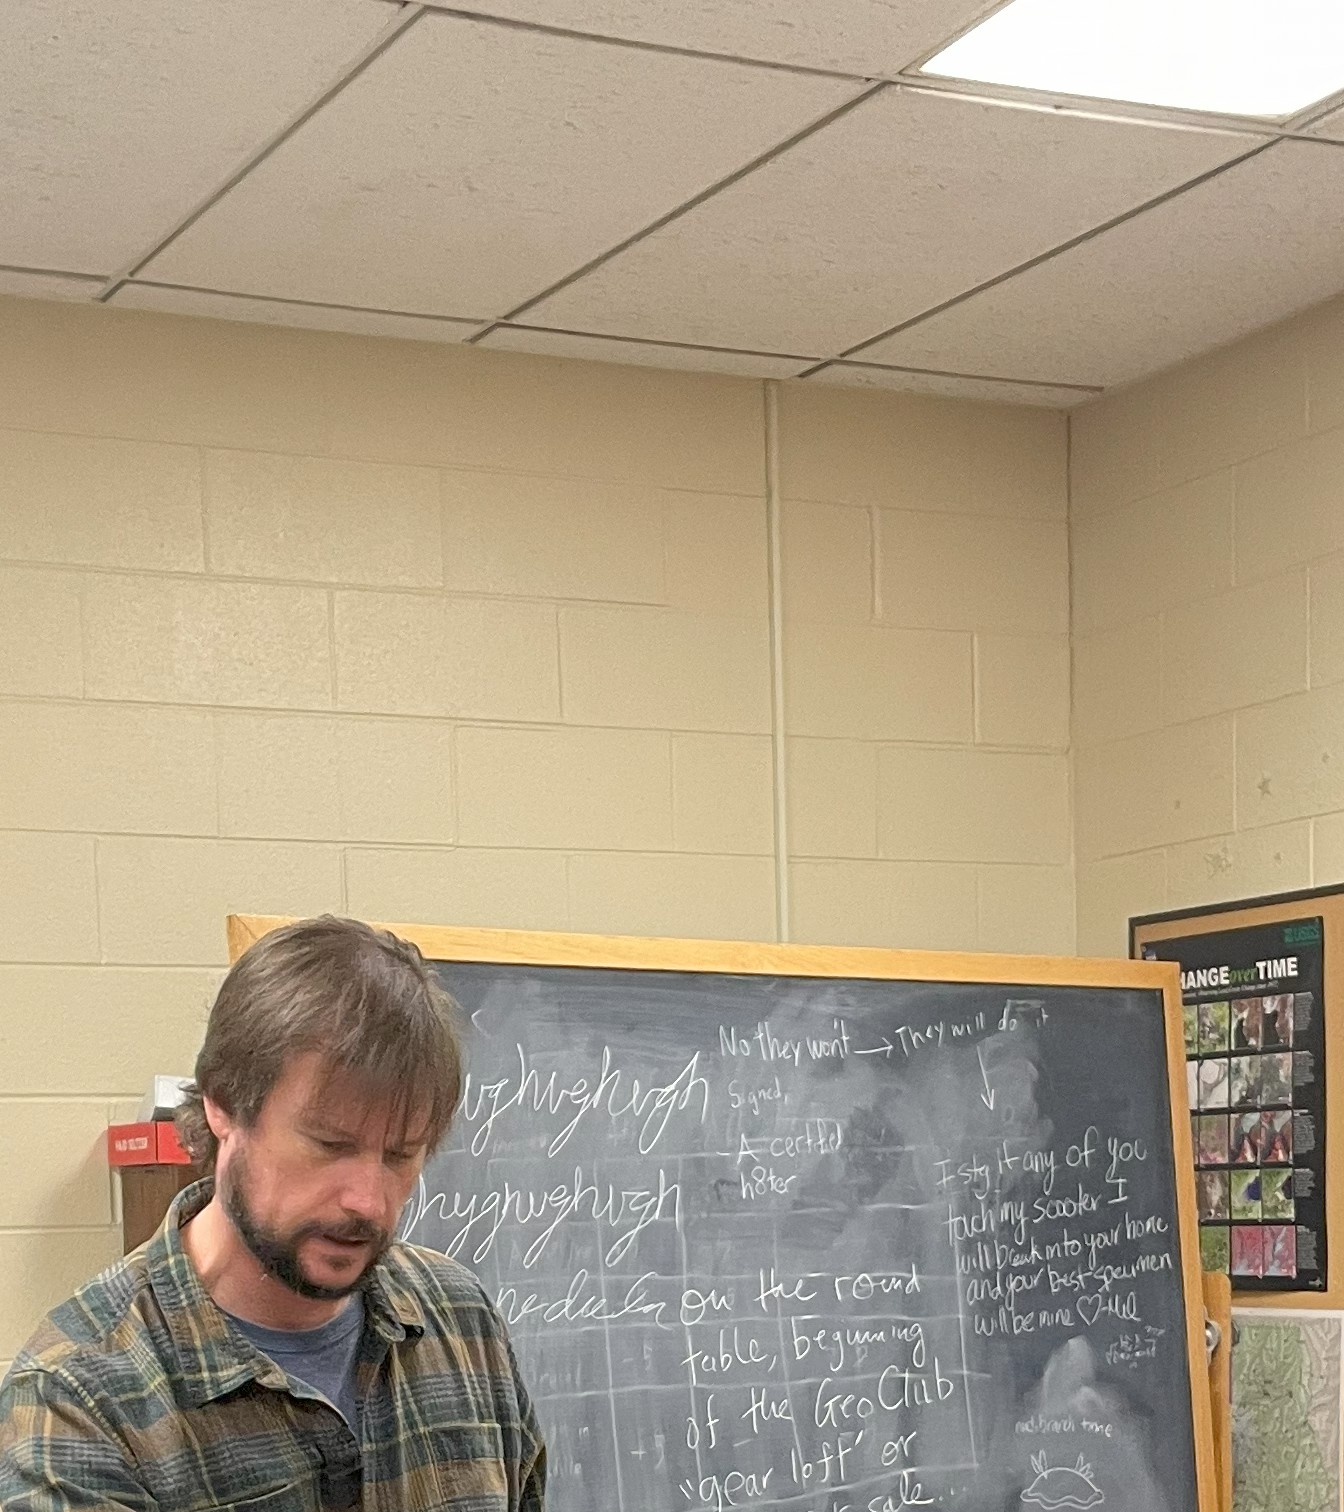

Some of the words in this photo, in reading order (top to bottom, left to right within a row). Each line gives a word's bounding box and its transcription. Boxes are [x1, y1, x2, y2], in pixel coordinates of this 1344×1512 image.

[1180, 966, 1230, 990] HANGE
[1256, 956, 1299, 980] TIME
[719, 1024, 750, 1057] No
[752, 1021, 802, 1067] they
[895, 1022, 944, 1058] They
[951, 1012, 986, 1038] will
[998, 1000, 1017, 1031] do
[1022, 1149, 1056, 1196] any
[1065, 1126, 1099, 1168] of
[1106, 1136, 1148, 1184] you
[1000, 1200, 1030, 1246] my
[1032, 1183, 1102, 1224] scooter
[1107, 1178, 1129, 1204] I
[958, 1240, 991, 1275] will
[1084, 1222, 1122, 1269] your
[1124, 1212, 1169, 1241] home
[753, 1269, 816, 1313] the
[834, 1263, 923, 1301] round
[966, 1270, 1005, 1306] and
[1004, 1266, 1044, 1311] your
[974, 1305, 1010, 1336] will
[1012, 1308, 1035, 1336] be
[1038, 1307, 1075, 1329] mine
[686, 1394, 720, 1450] of
[741, 1386, 794, 1434] the
[880, 1432, 918, 1466] or
